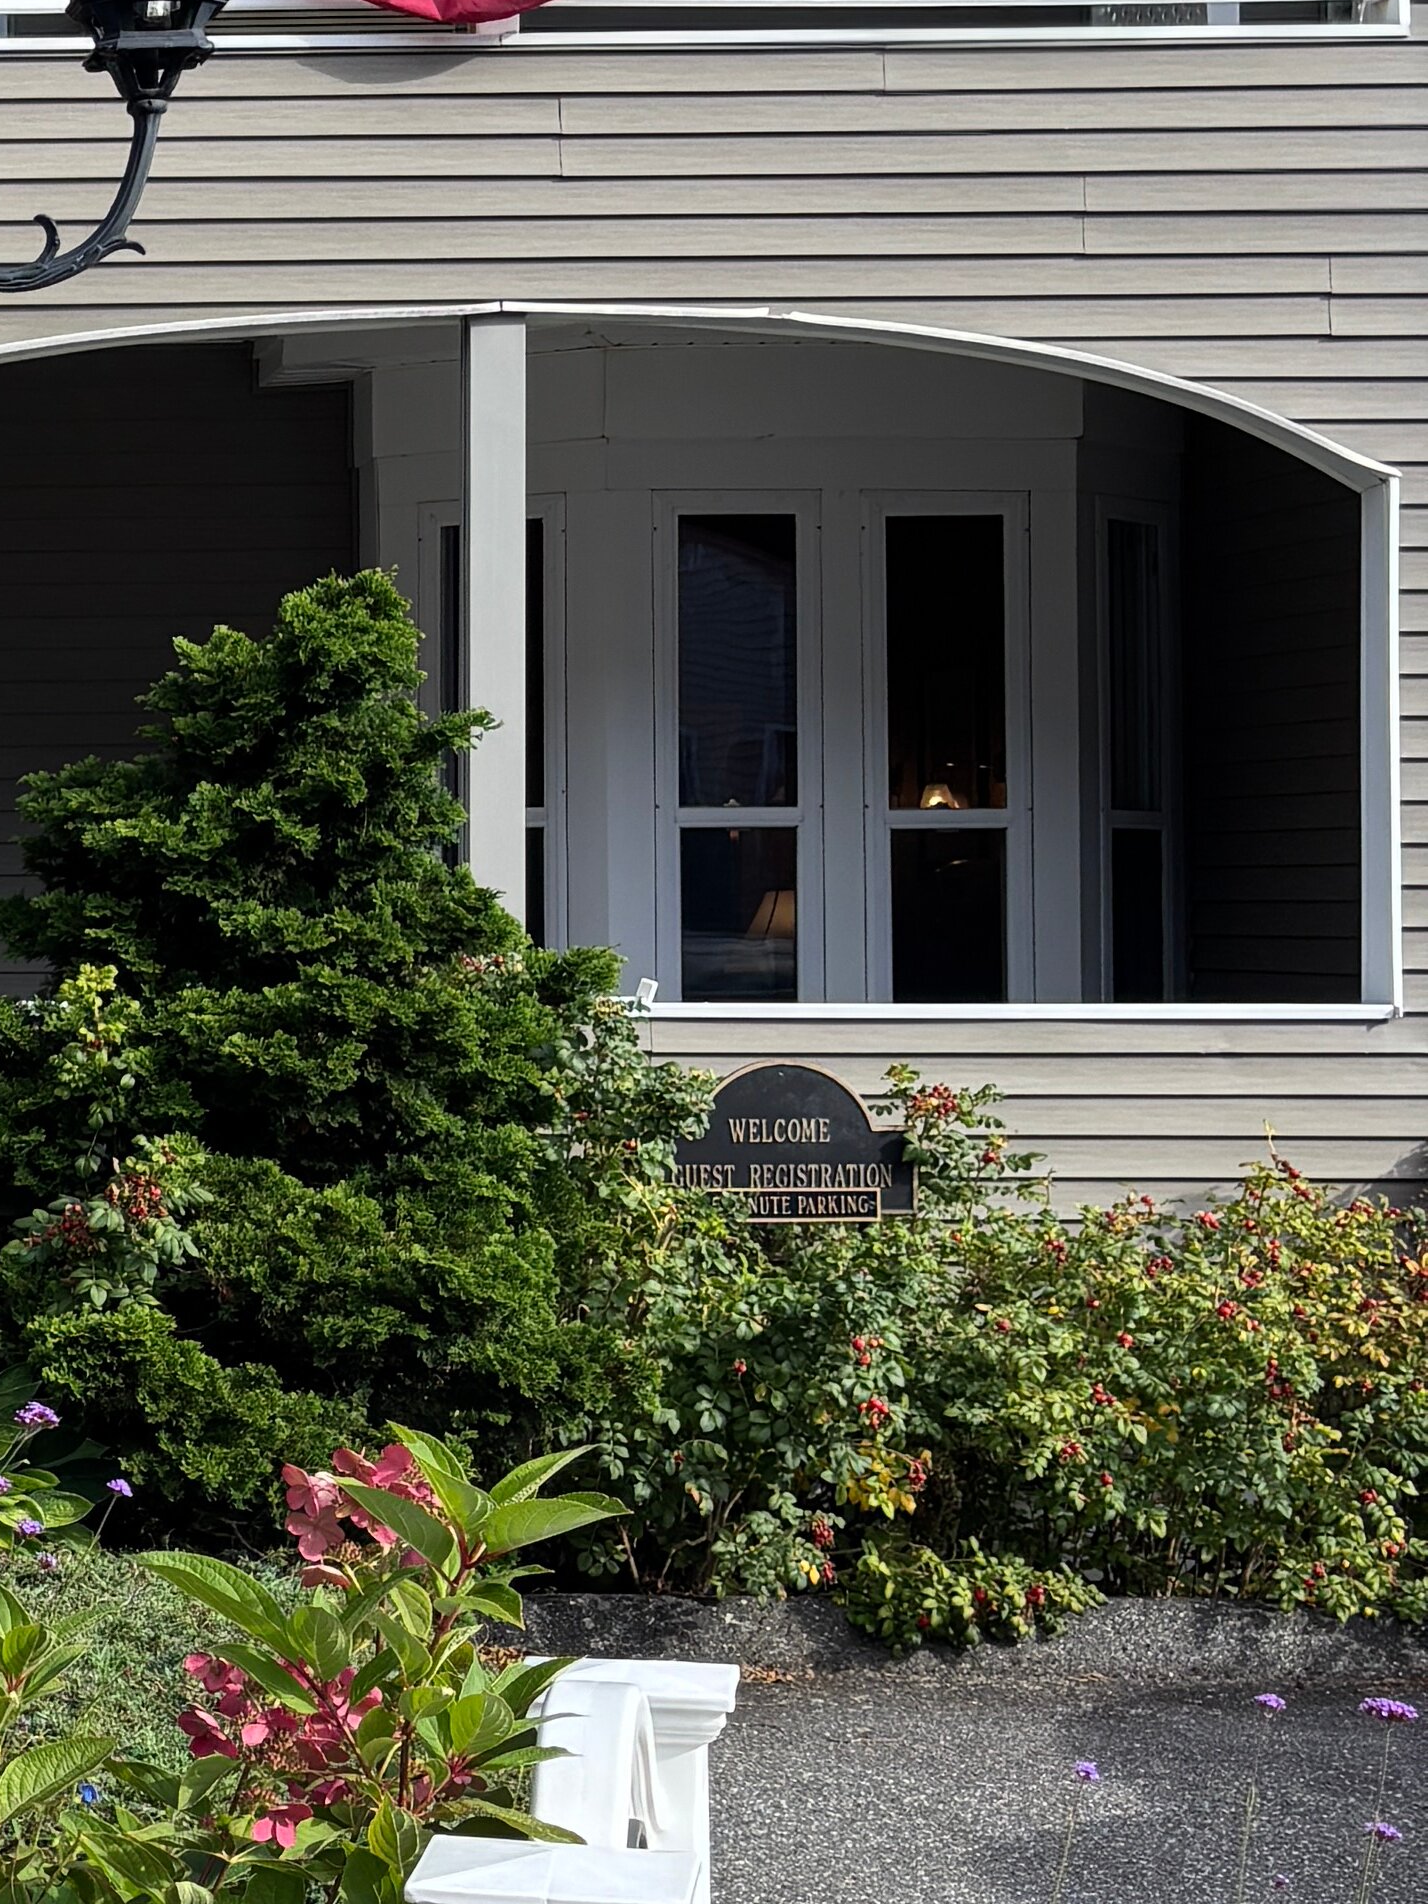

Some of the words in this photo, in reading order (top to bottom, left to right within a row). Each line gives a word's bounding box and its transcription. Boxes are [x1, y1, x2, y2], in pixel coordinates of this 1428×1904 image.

[728, 1117, 831, 1144] WELCOME
[671, 1163, 736, 1189] GUEST
[749, 1163, 893, 1189] REGISTRATION
[741, 1195, 792, 1215] NUTE
[797, 1195, 869, 1215] PARKING
